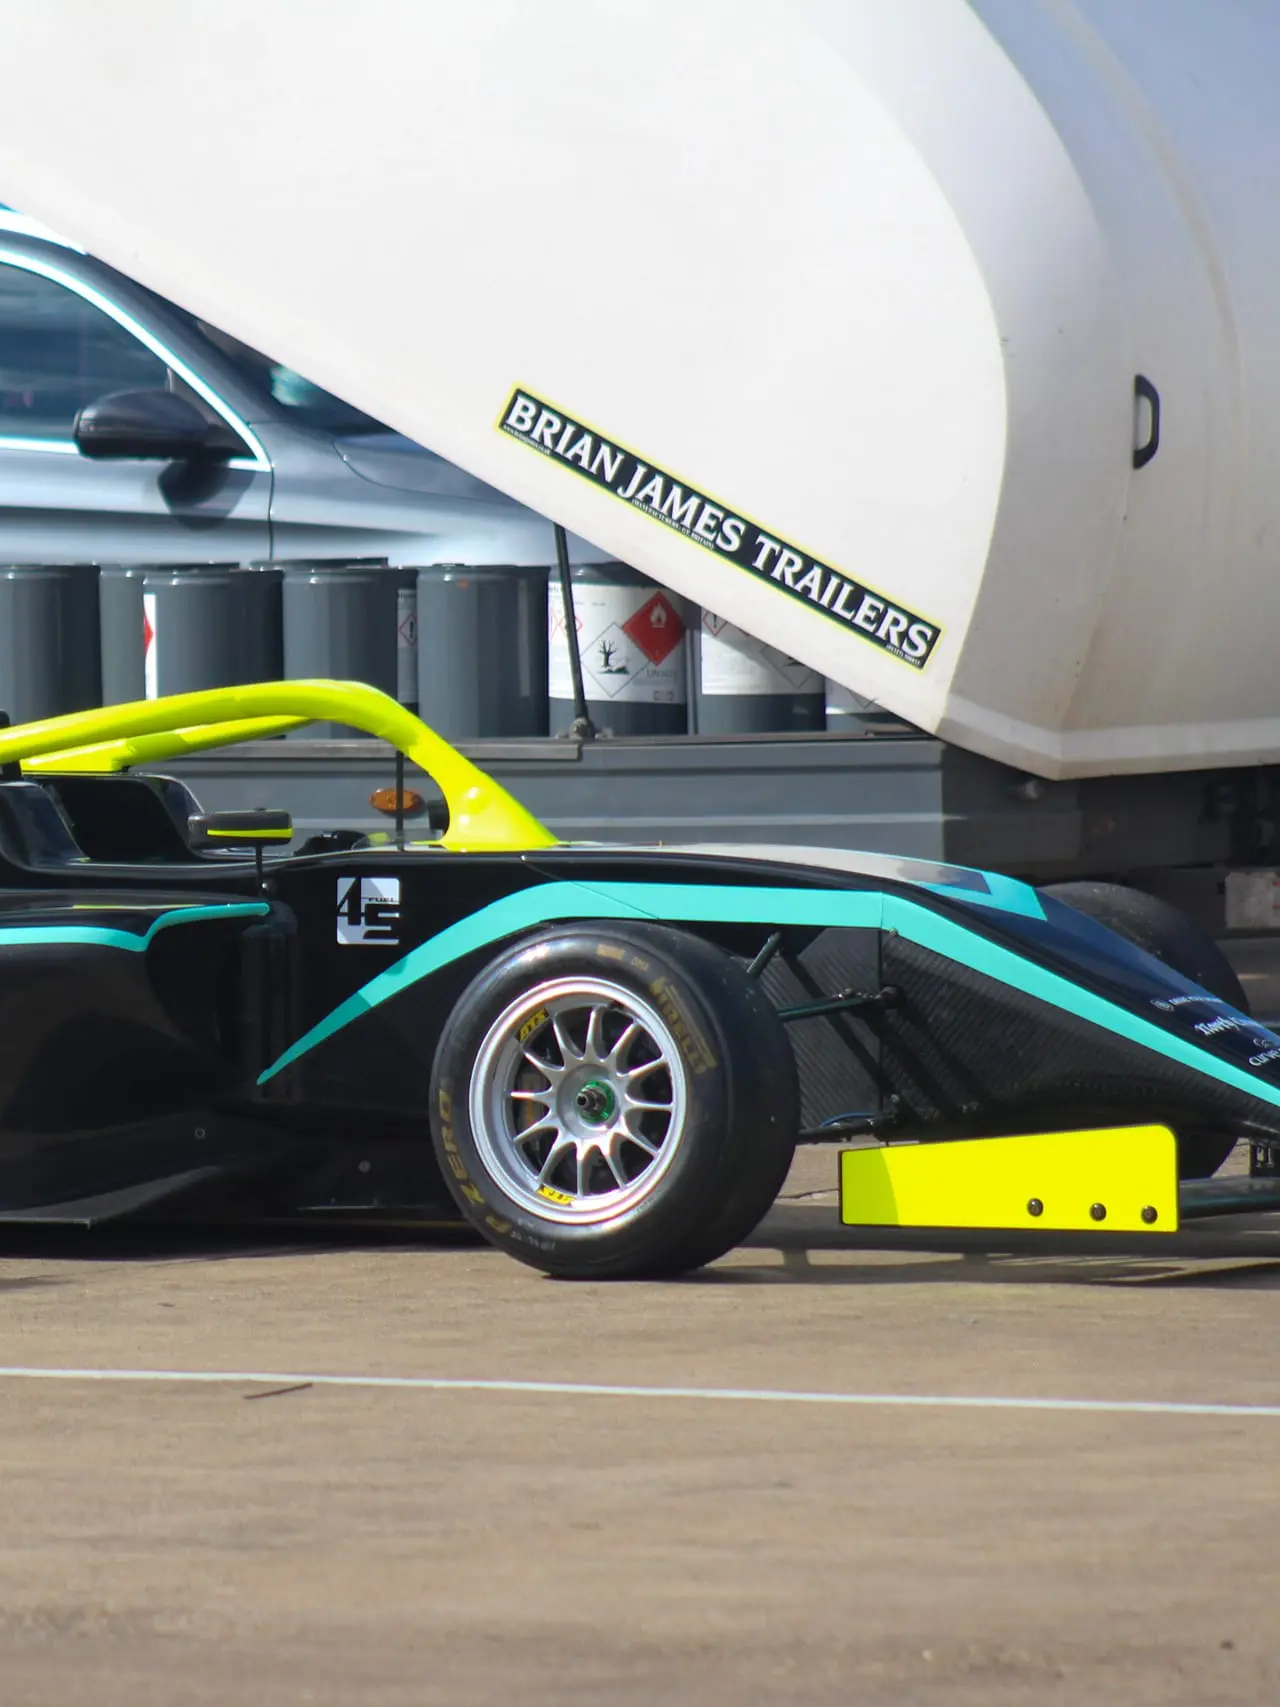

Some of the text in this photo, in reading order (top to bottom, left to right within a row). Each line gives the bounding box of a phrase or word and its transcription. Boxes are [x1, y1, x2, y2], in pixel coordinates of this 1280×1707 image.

[505, 394, 624, 483] BRIAN
[616, 461, 747, 553] JAMES
[752, 534, 936, 659] TRAILERS
[438, 1088, 486, 1206] ZERO
